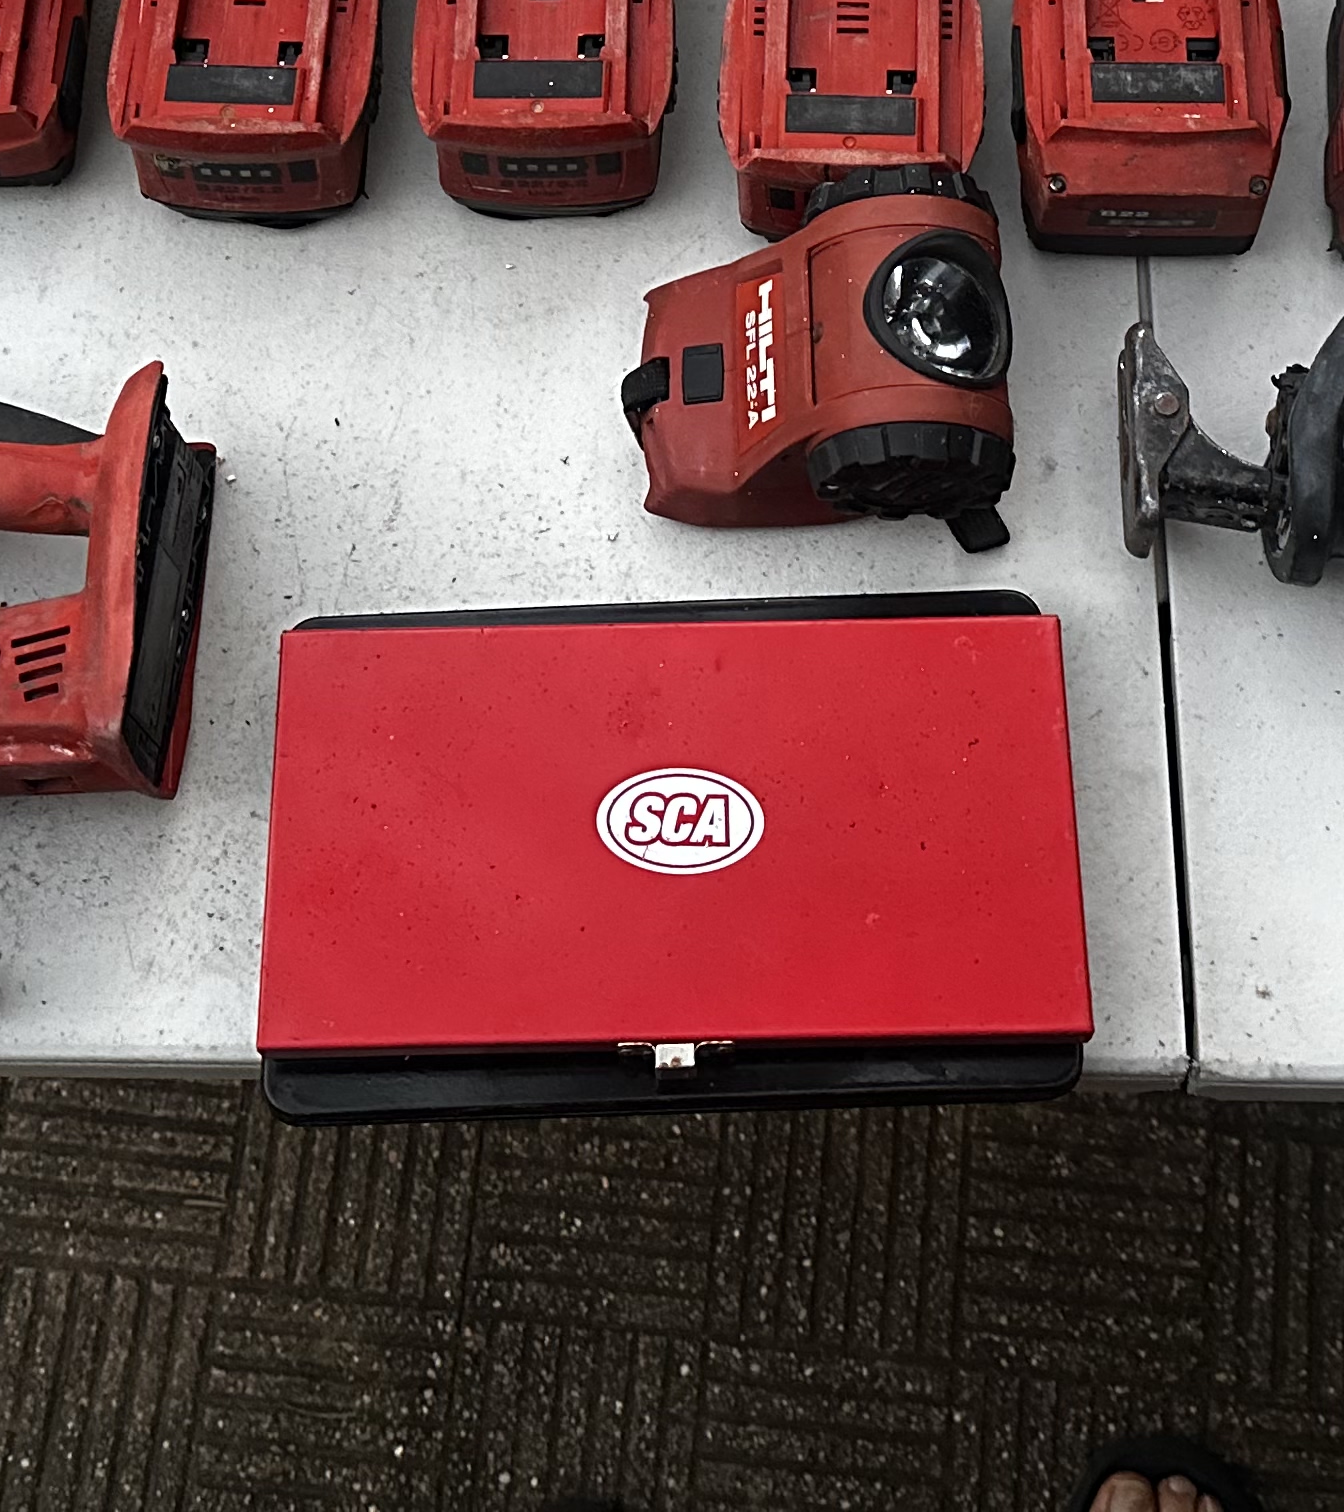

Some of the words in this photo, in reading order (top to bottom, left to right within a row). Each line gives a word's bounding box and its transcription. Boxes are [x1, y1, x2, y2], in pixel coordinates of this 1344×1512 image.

[745, 310, 756, 361] SFL
[758, 278, 777, 424] HILTI
[746, 365, 759, 430] 22-A
[624, 791, 731, 848] SCA
